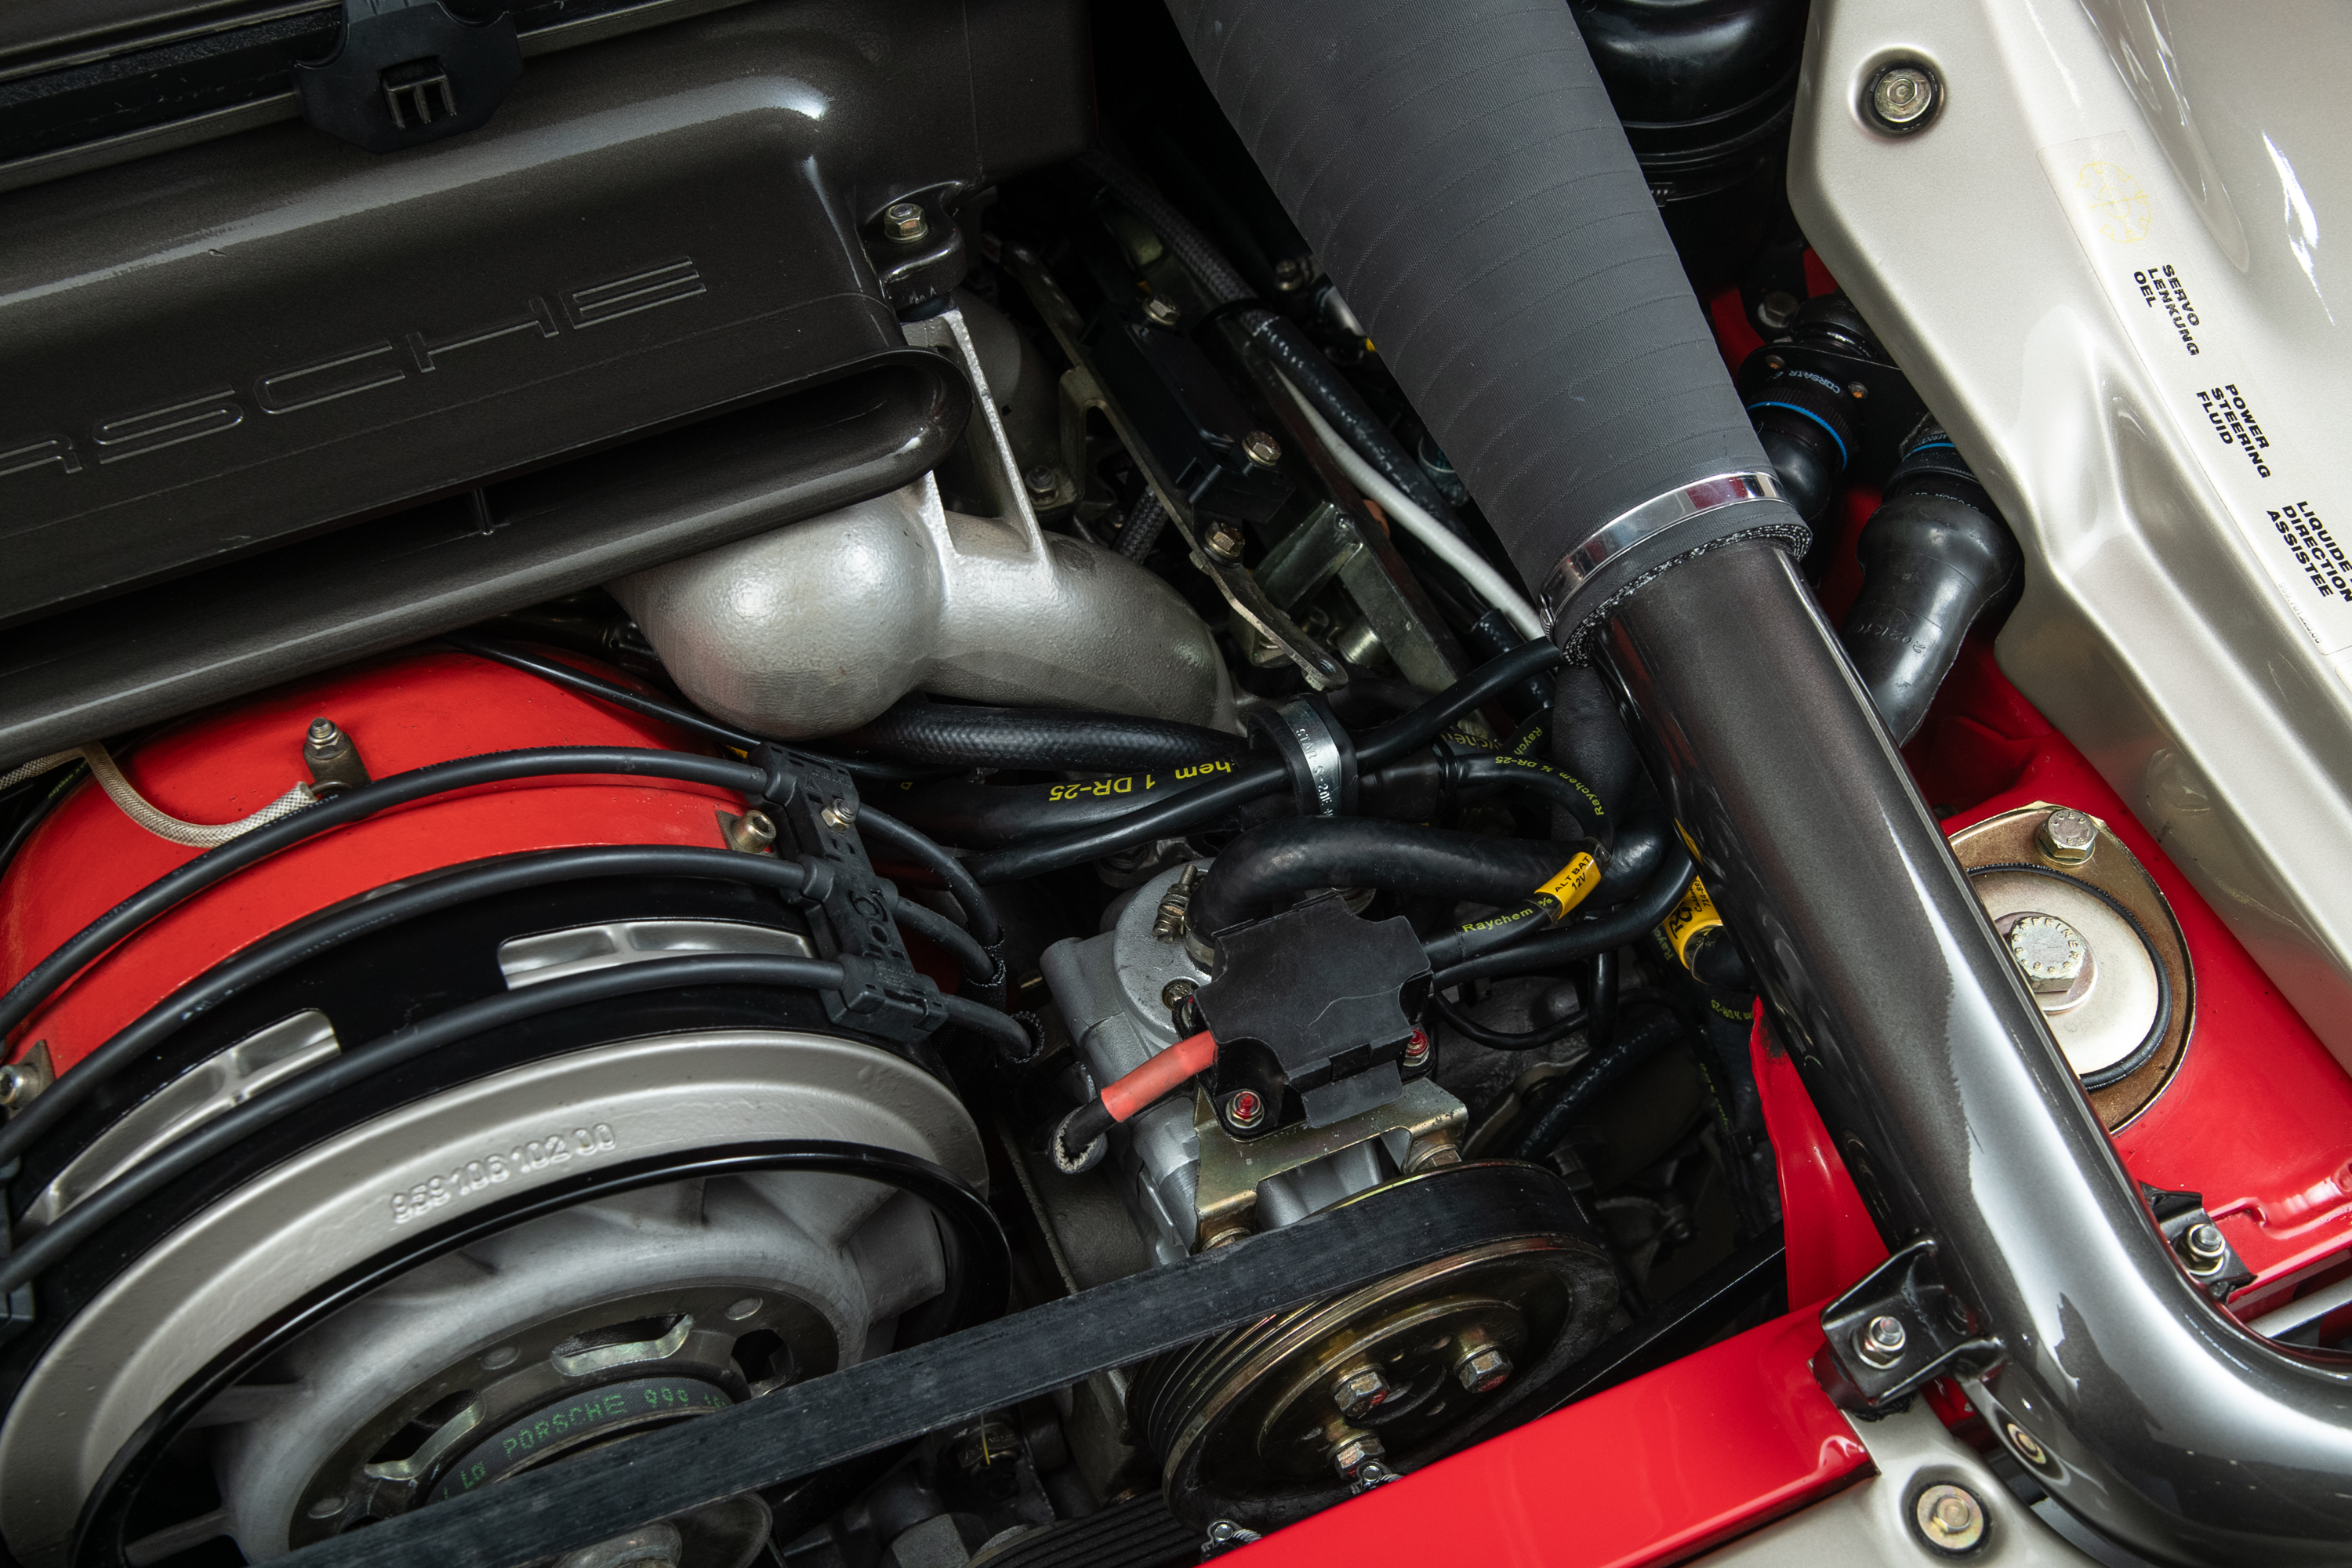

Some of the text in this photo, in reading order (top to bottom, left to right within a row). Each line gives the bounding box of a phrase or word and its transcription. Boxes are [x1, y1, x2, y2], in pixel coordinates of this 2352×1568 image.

[2133, 270, 2157, 307] OEL
[2162, 264, 2200, 326] SERVO
[2147, 267, 2200, 356] LENKUNG
[1788, 370, 1841, 394] CORSAIR
[2196, 390, 2234, 445] FLUID
[2211, 387, 2271, 478] STEERING
[2225, 383, 2270, 448] POWER
[2267, 510, 2334, 597] ASSISTEE
[2282, 505, 2352, 602] DIRECTION
[2296, 500, 2352, 572] LIQUIDE
[1048, 760, 1236, 801] hem 1 DR-25
[1494, 756, 1538, 768] DR-25
[1559, 771, 1605, 816] Raychem
[1555, 856, 1591, 892] ALT BAT
[1571, 873, 1587, 891] 12V
[1461, 908, 1534, 933] Raychem
[1653, 926, 1675, 961] Rayc
[1711, 999, 1735, 1020] DR-25
[502, 1393, 626, 1461] PORSCHE
[644, 1387, 689, 1409] 999
